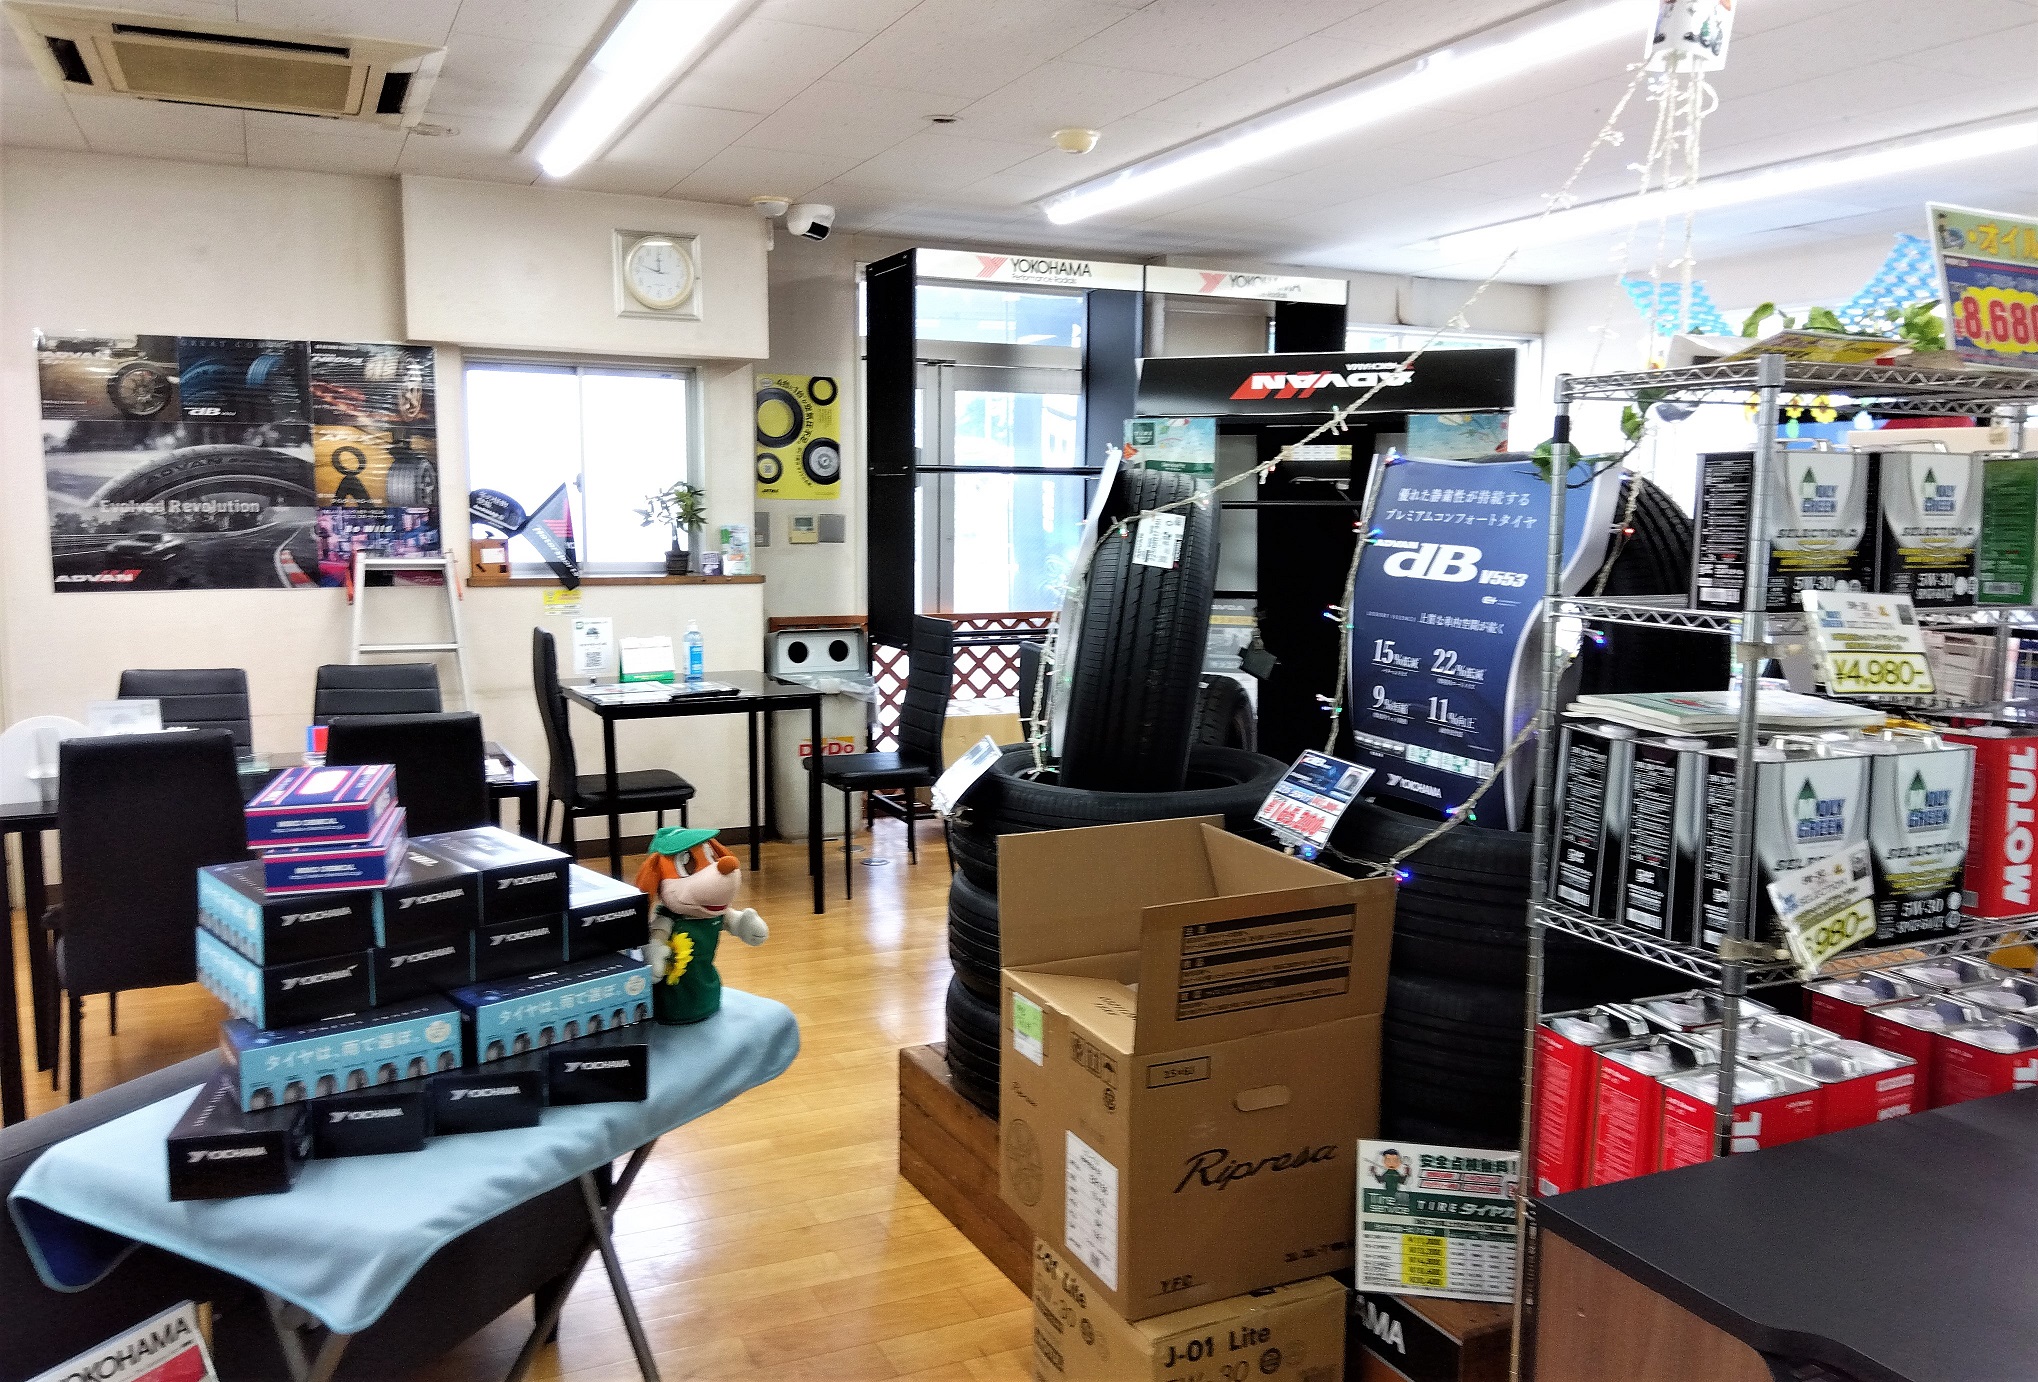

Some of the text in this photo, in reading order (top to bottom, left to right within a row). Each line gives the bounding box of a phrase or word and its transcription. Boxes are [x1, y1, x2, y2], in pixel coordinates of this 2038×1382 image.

[1010, 258, 1092, 277] YOKOHAMA
[1251, 371, 1415, 390] ADVAN
[100, 500, 260, 514] Evolved Revolution
[1385, 508, 1537, 529] プレミアムコンフォートタイヤ
[1383, 542, 1483, 583] dB
[55, 573, 133, 583] ADVAN
[1478, 569, 1529, 588] V553
[2002, 746, 2037, 906] MOTUL
[1901, 898, 1944, 917] 5W-30
[564, 1059, 631, 1073] YOKOHAMA
[450, 1086, 521, 1100] YOKOHAMA
[329, 1107, 404, 1123] YOKOHAMA
[187, 1146, 268, 1163] YOKOHAMA
[1173, 1145, 1338, 1194] Ripresa
[1417, 1200, 1458, 1213] TIRE
[1164, 1327, 1271, 1369] J-01 Lite
